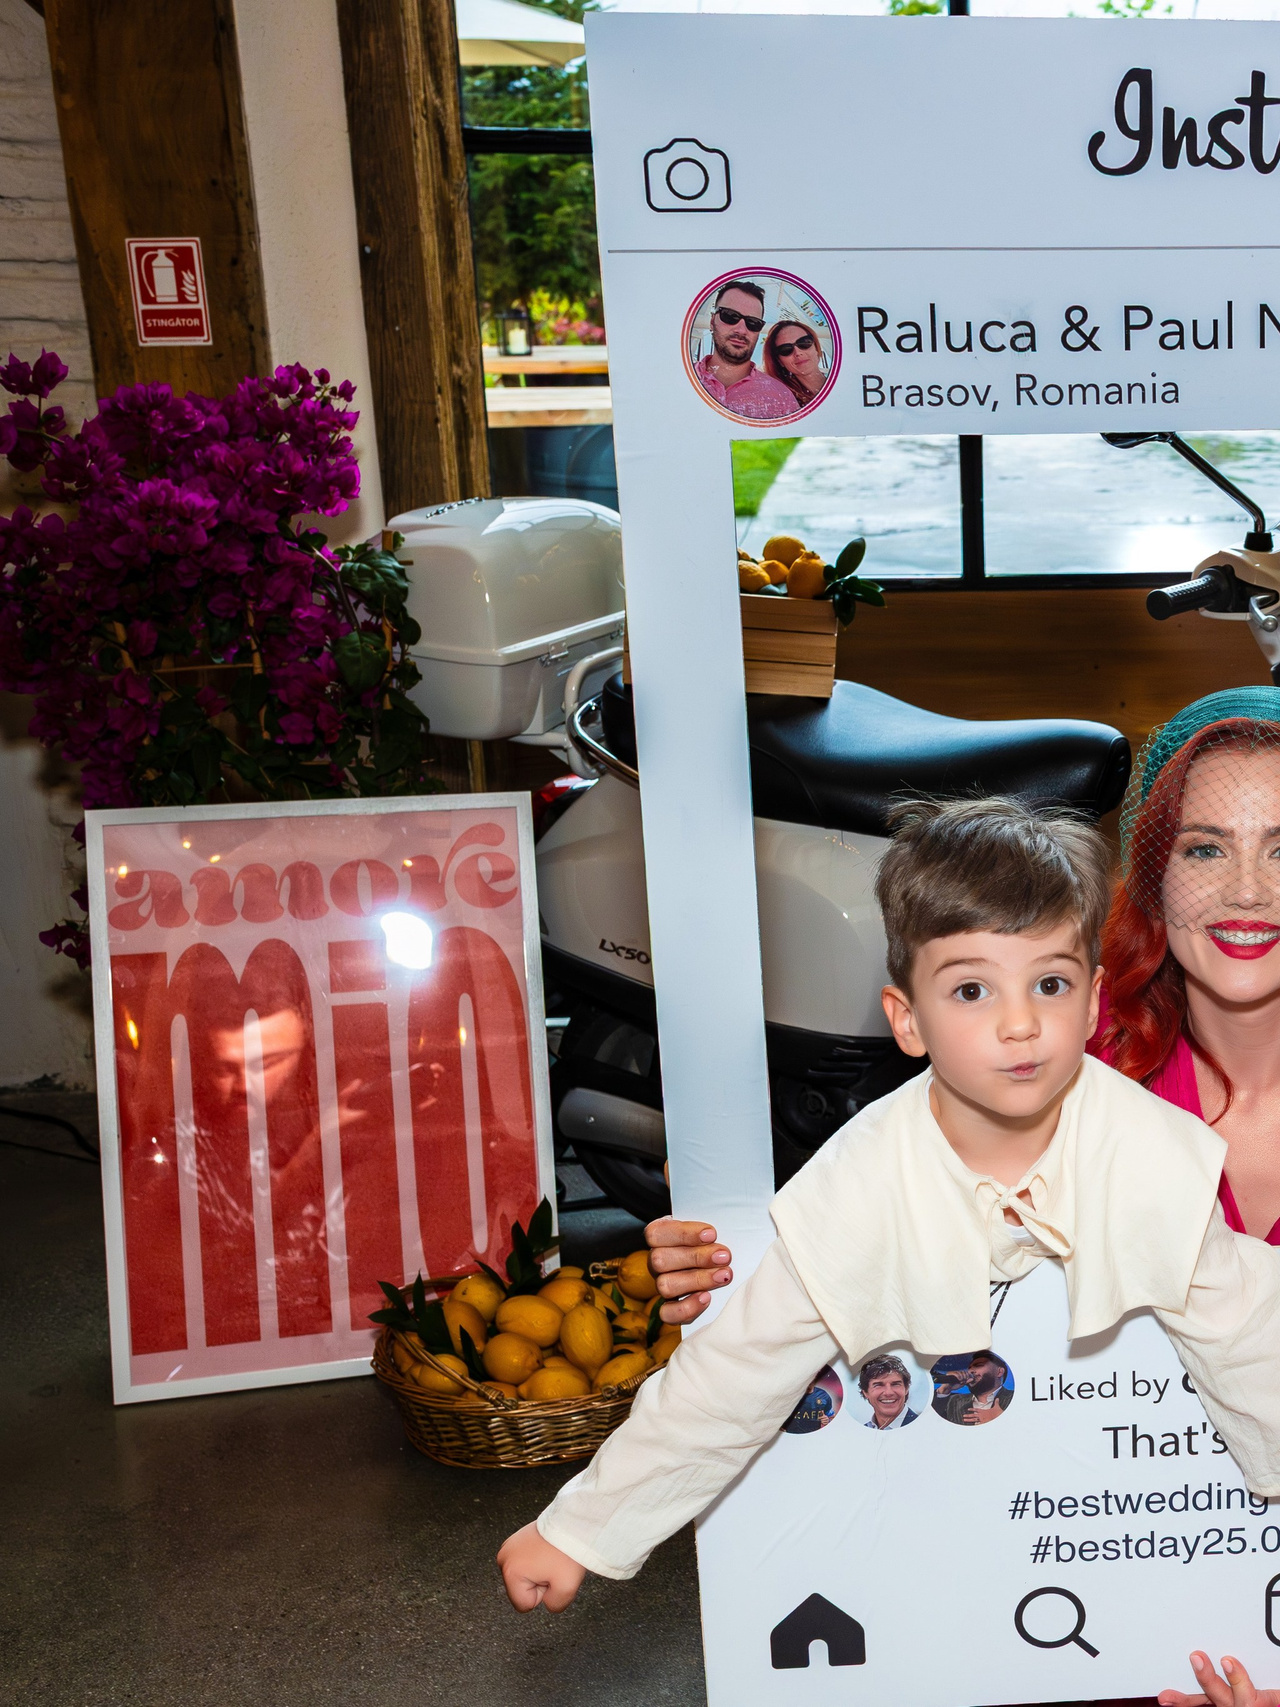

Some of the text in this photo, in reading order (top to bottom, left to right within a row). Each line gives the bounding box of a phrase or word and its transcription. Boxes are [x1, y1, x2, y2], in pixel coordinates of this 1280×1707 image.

[857, 302, 1037, 354] Raluca
[1060, 304, 1103, 353] &
[1123, 300, 1235, 351] Paul
[862, 371, 1180, 412] Brasov, Romania
[108, 823, 518, 931] amore
[598, 938, 652, 965] LX50
[110, 926, 540, 1356] mio
[1031, 1371, 1118, 1402] Liked
[1132, 1370, 1170, 1404] by
[1102, 1421, 1229, 1459] That's
[1008, 1482, 1269, 1520] #bestwedding
